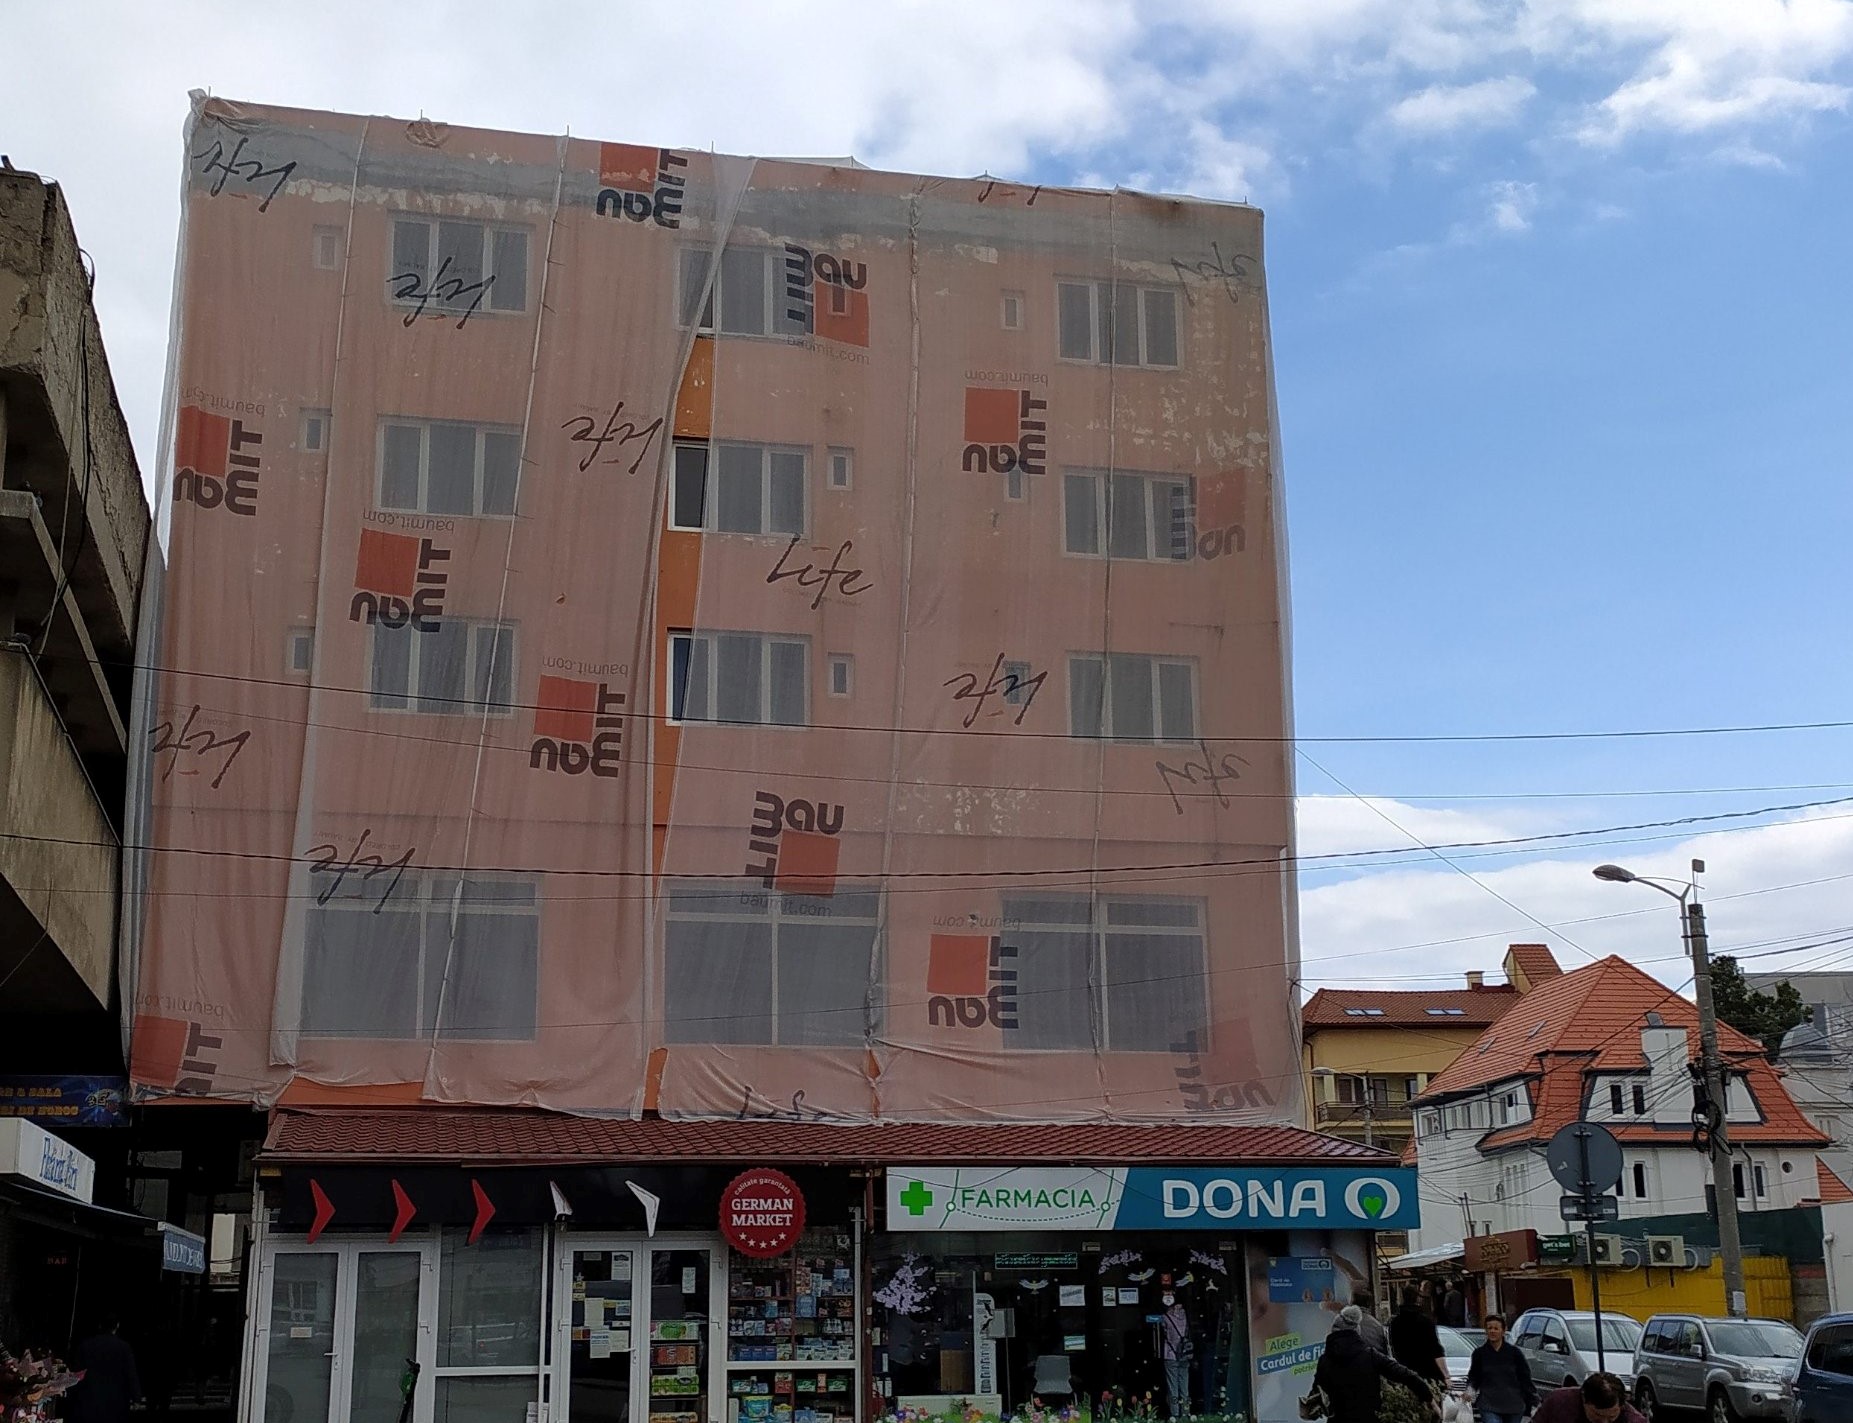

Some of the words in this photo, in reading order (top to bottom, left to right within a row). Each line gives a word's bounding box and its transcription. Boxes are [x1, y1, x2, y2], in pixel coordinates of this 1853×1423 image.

[561, 402, 663, 475] Life
[362, 507, 455, 534] baumit.com
[766, 533, 874, 611] Life
[542, 655, 629, 678] baumit.com
[943, 652, 1048, 728] Life
[731, 1198, 794, 1211] GERMAN
[961, 1189, 1096, 1208] FARMACIA
[1162, 1178, 1326, 1219] DONA
[731, 1214, 793, 1226] MARKET
[1269, 1337, 1299, 1351] Alege
[1261, 1353, 1297, 1371] Cardul
[1298, 1349, 1311, 1362] de
